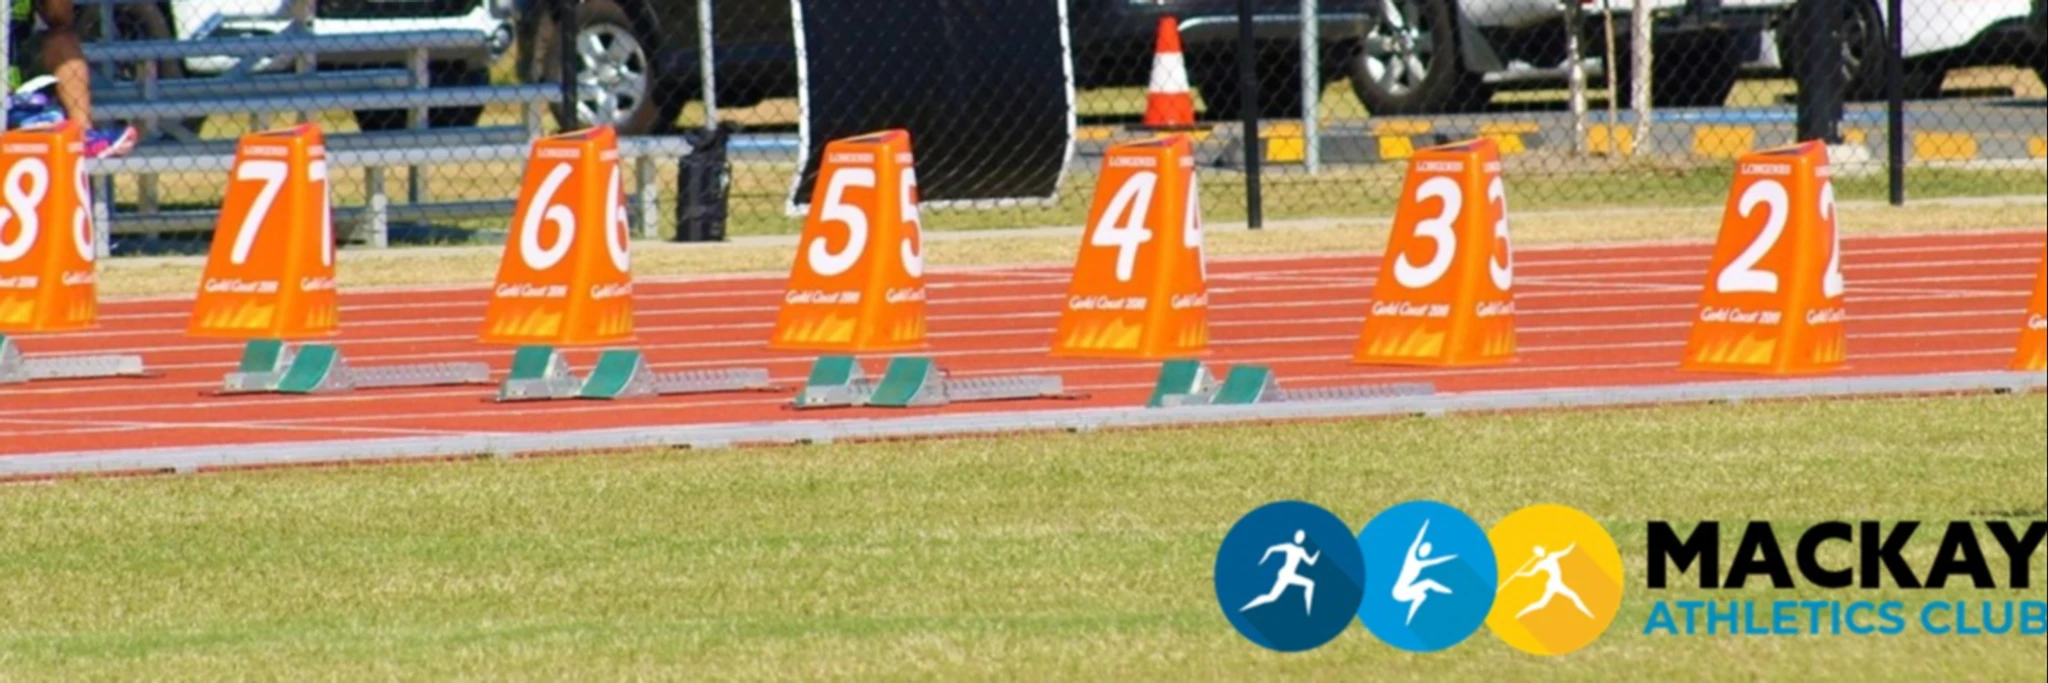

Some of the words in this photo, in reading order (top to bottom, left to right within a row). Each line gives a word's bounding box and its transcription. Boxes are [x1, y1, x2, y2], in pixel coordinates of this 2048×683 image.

[0, 157, 49, 262] 8
[230, 160, 289, 265] 7
[520, 162, 576, 271] 6
[605, 163, 630, 273] 6
[808, 167, 876, 277] 5
[900, 166, 924, 278] 5
[1091, 170, 1158, 282] 4
[1393, 175, 1463, 289] 3
[1487, 175, 1514, 292] 3
[1716, 178, 1789, 294] 2
